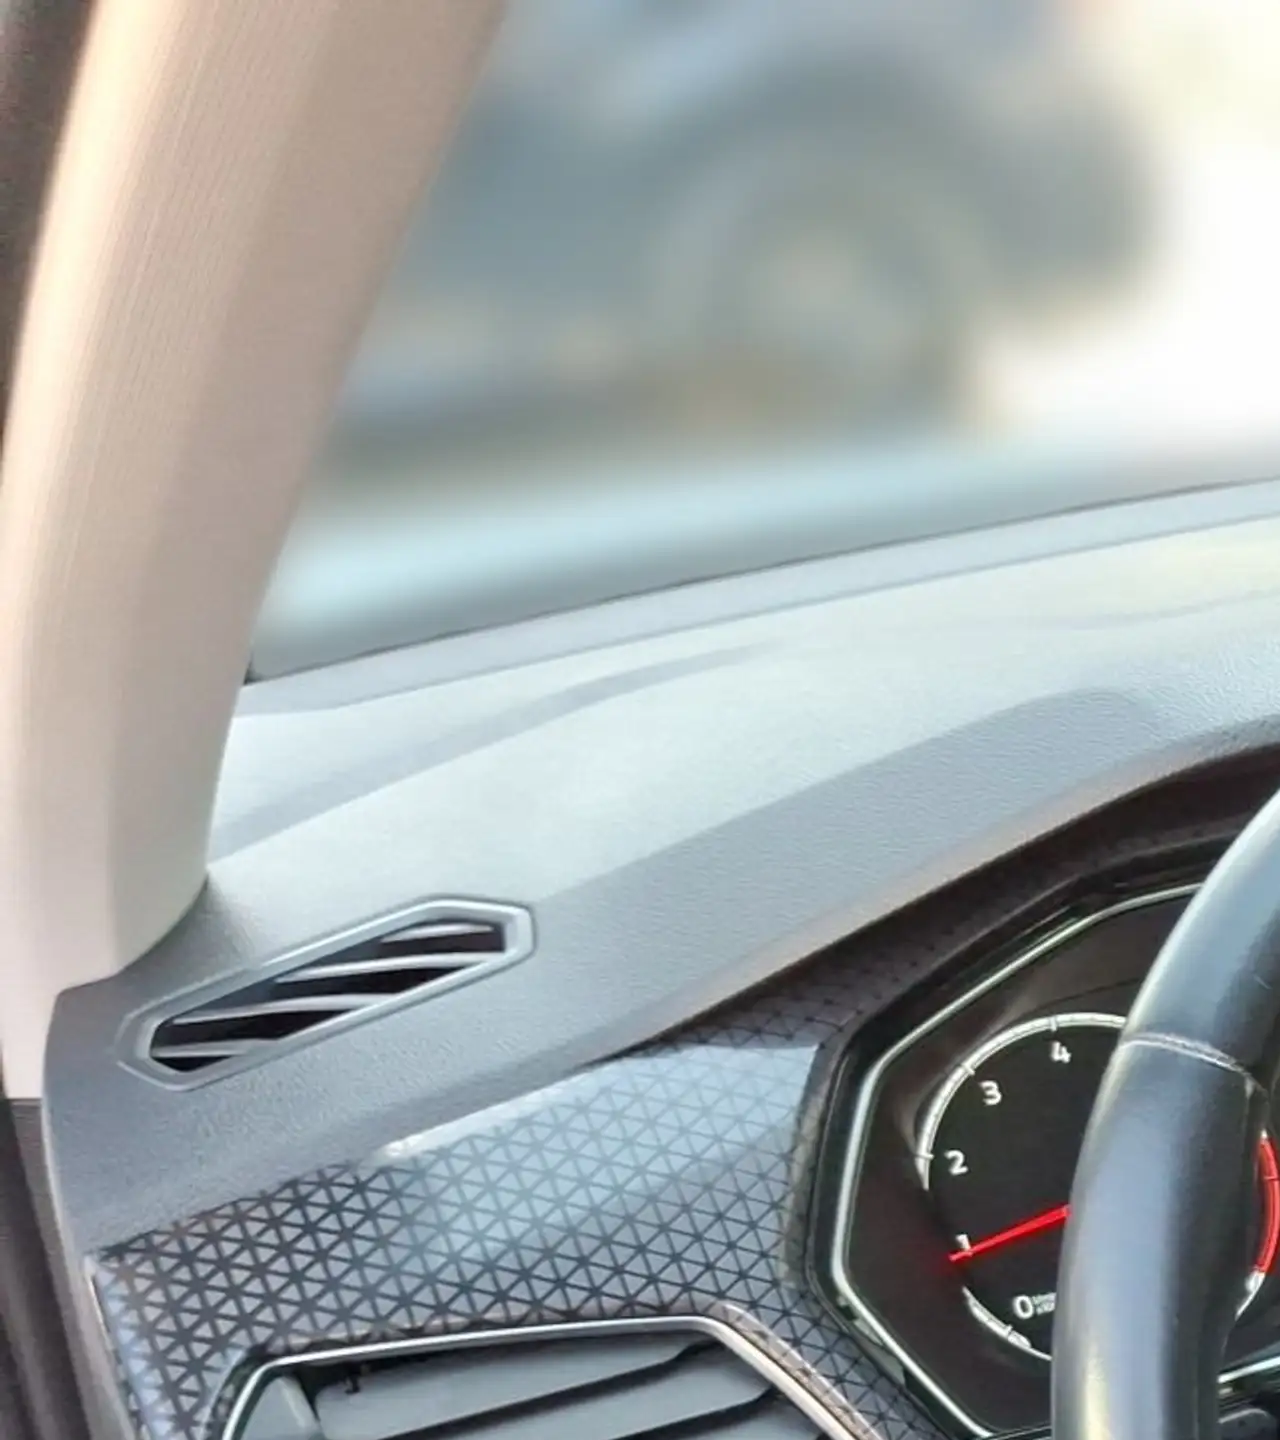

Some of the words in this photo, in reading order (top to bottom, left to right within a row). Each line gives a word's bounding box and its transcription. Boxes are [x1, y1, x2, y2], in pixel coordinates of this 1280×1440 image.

[1050, 1041, 1071, 1063] 4
[980, 1080, 1001, 1106] 3
[944, 1149, 968, 1176] 2
[956, 1233, 973, 1256] 1
[1013, 1295, 1034, 1319] 0
